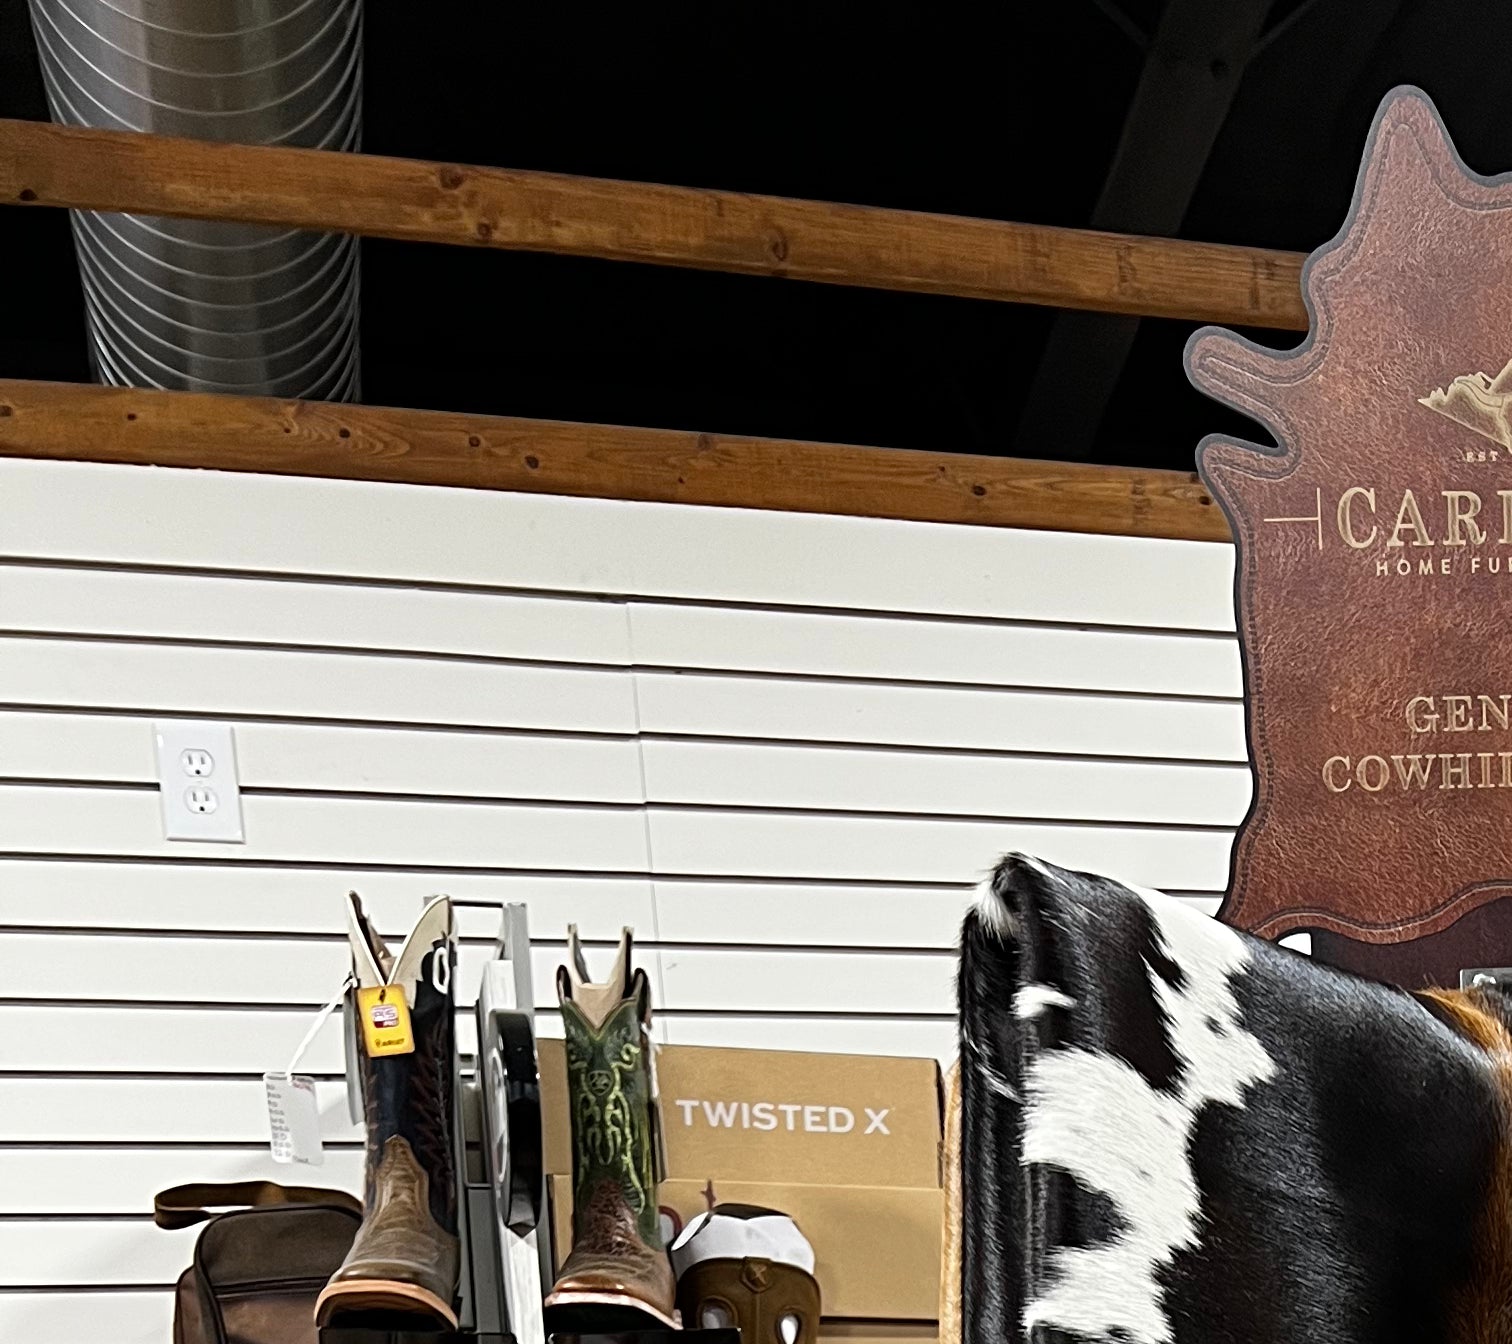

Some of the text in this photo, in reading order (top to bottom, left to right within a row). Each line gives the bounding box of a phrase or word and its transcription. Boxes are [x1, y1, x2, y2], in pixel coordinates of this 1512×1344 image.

[1376, 552, 1453, 577] HOME
[675, 1099, 892, 1136] TWISTED X
